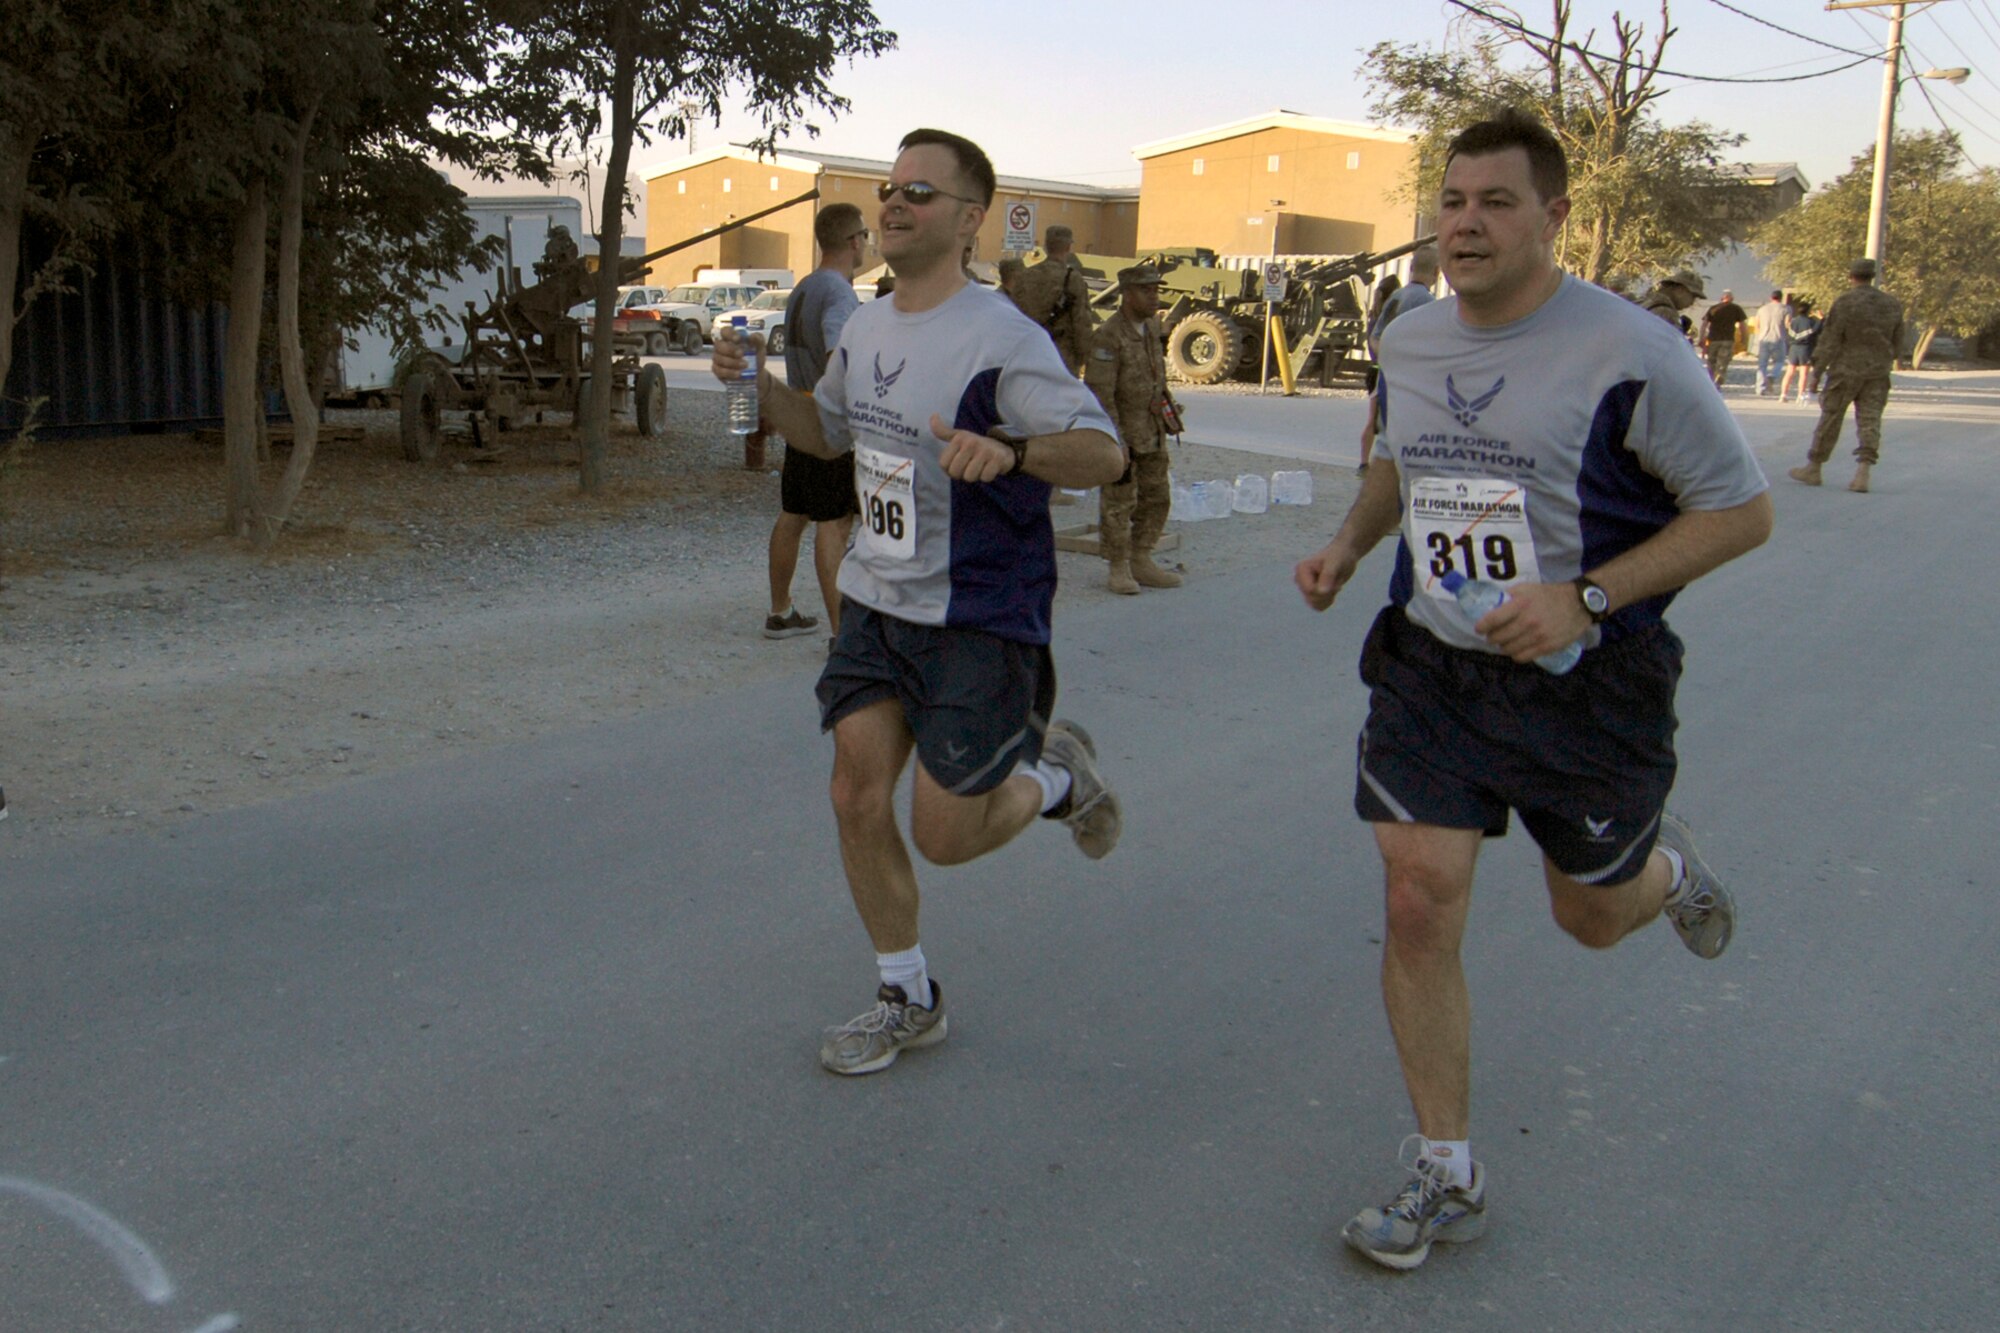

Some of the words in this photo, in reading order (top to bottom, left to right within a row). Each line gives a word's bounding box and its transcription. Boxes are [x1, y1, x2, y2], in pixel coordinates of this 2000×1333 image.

[853, 400, 869, 411] AIR
[871, 404, 903, 421] FORCE
[1418, 433, 1446, 443] AIR
[1452, 435, 1511, 451] FORCE
[1401, 446, 1536, 469] MARATHON
[863, 490, 904, 541] 196
[1413, 498, 1427, 508] AIR
[1429, 499, 1458, 510] FORCE
[1460, 501, 1521, 513] MARATHON
[1427, 531, 1517, 582] 319
